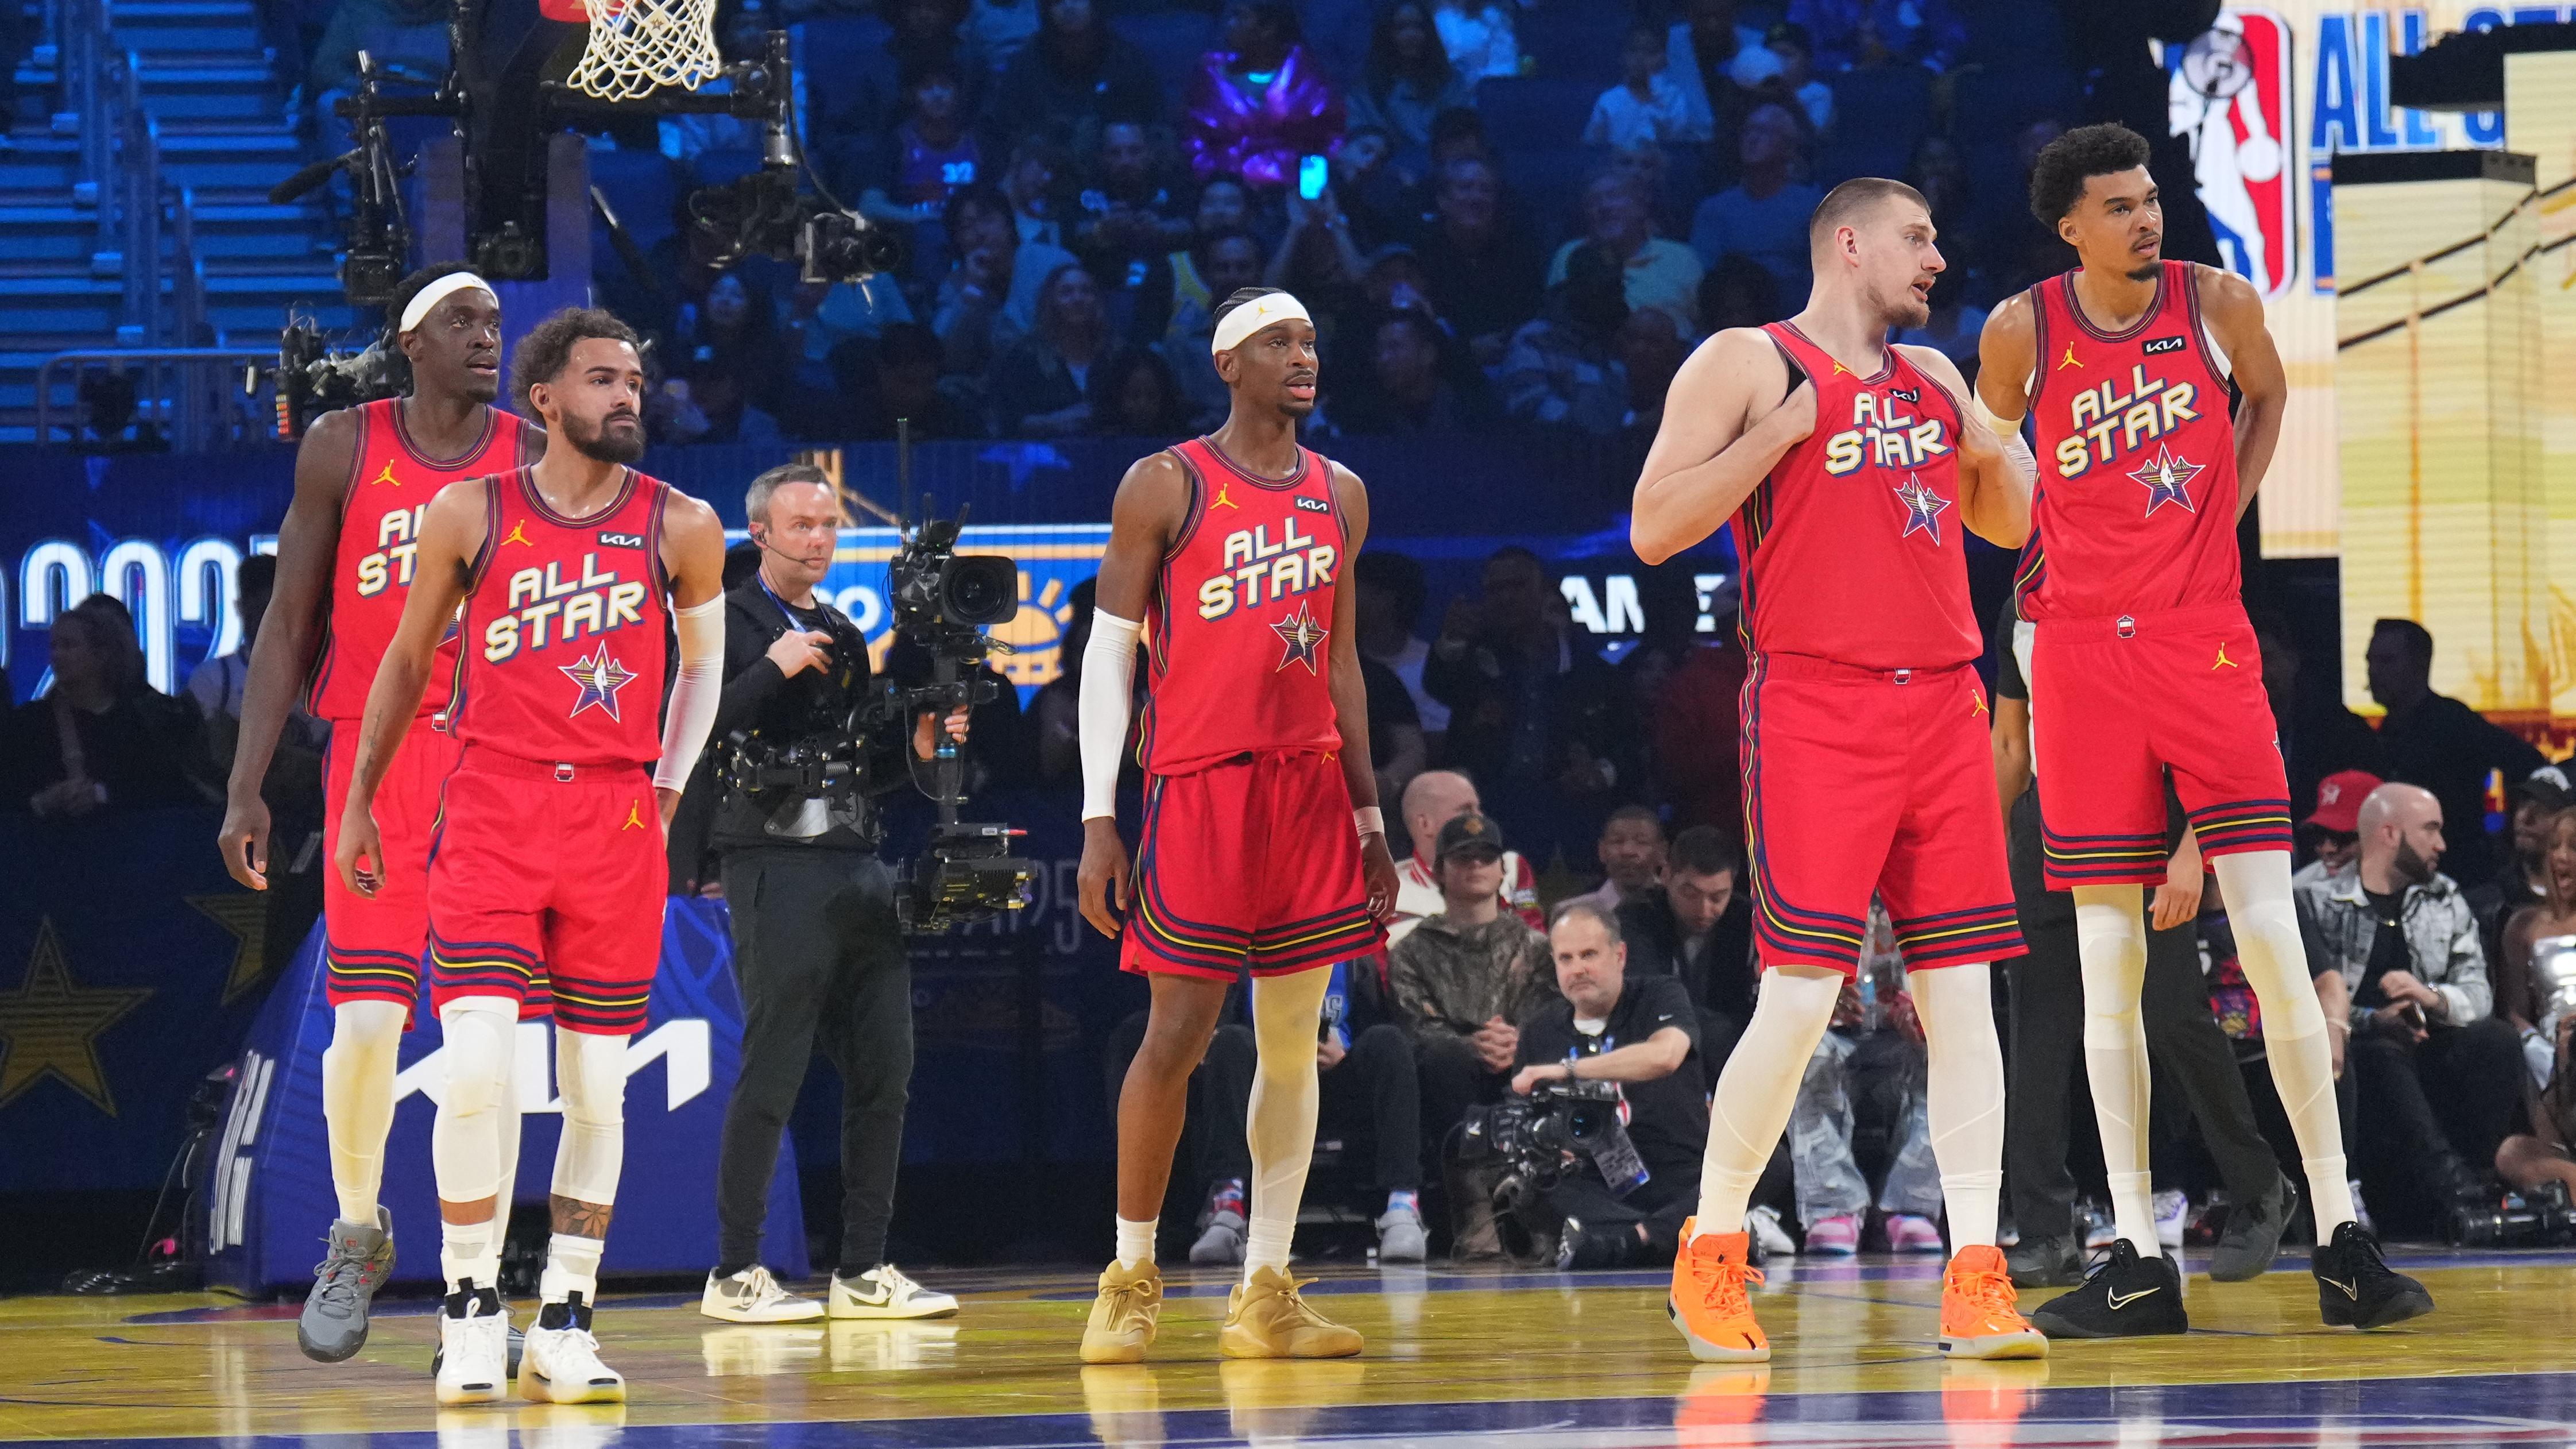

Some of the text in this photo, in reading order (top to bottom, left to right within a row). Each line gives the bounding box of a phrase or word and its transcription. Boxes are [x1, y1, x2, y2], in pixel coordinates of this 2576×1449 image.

[2146, 337, 2183, 353] KIA
[1854, 392, 1913, 430] ALL
[2071, 363, 2167, 432] ALL
[1825, 418, 1954, 478] STAR
[2055, 381, 2204, 481] STAR
[1297, 497, 1328, 511] KIA
[601, 533, 642, 547] KIA
[1224, 516, 1314, 572] ALL
[357, 543, 417, 598] ST
[509, 551, 618, 610] ALL
[1198, 544, 1335, 622] STAR
[20, 537, 279, 697] 202
[484, 580, 648, 666] STAR
